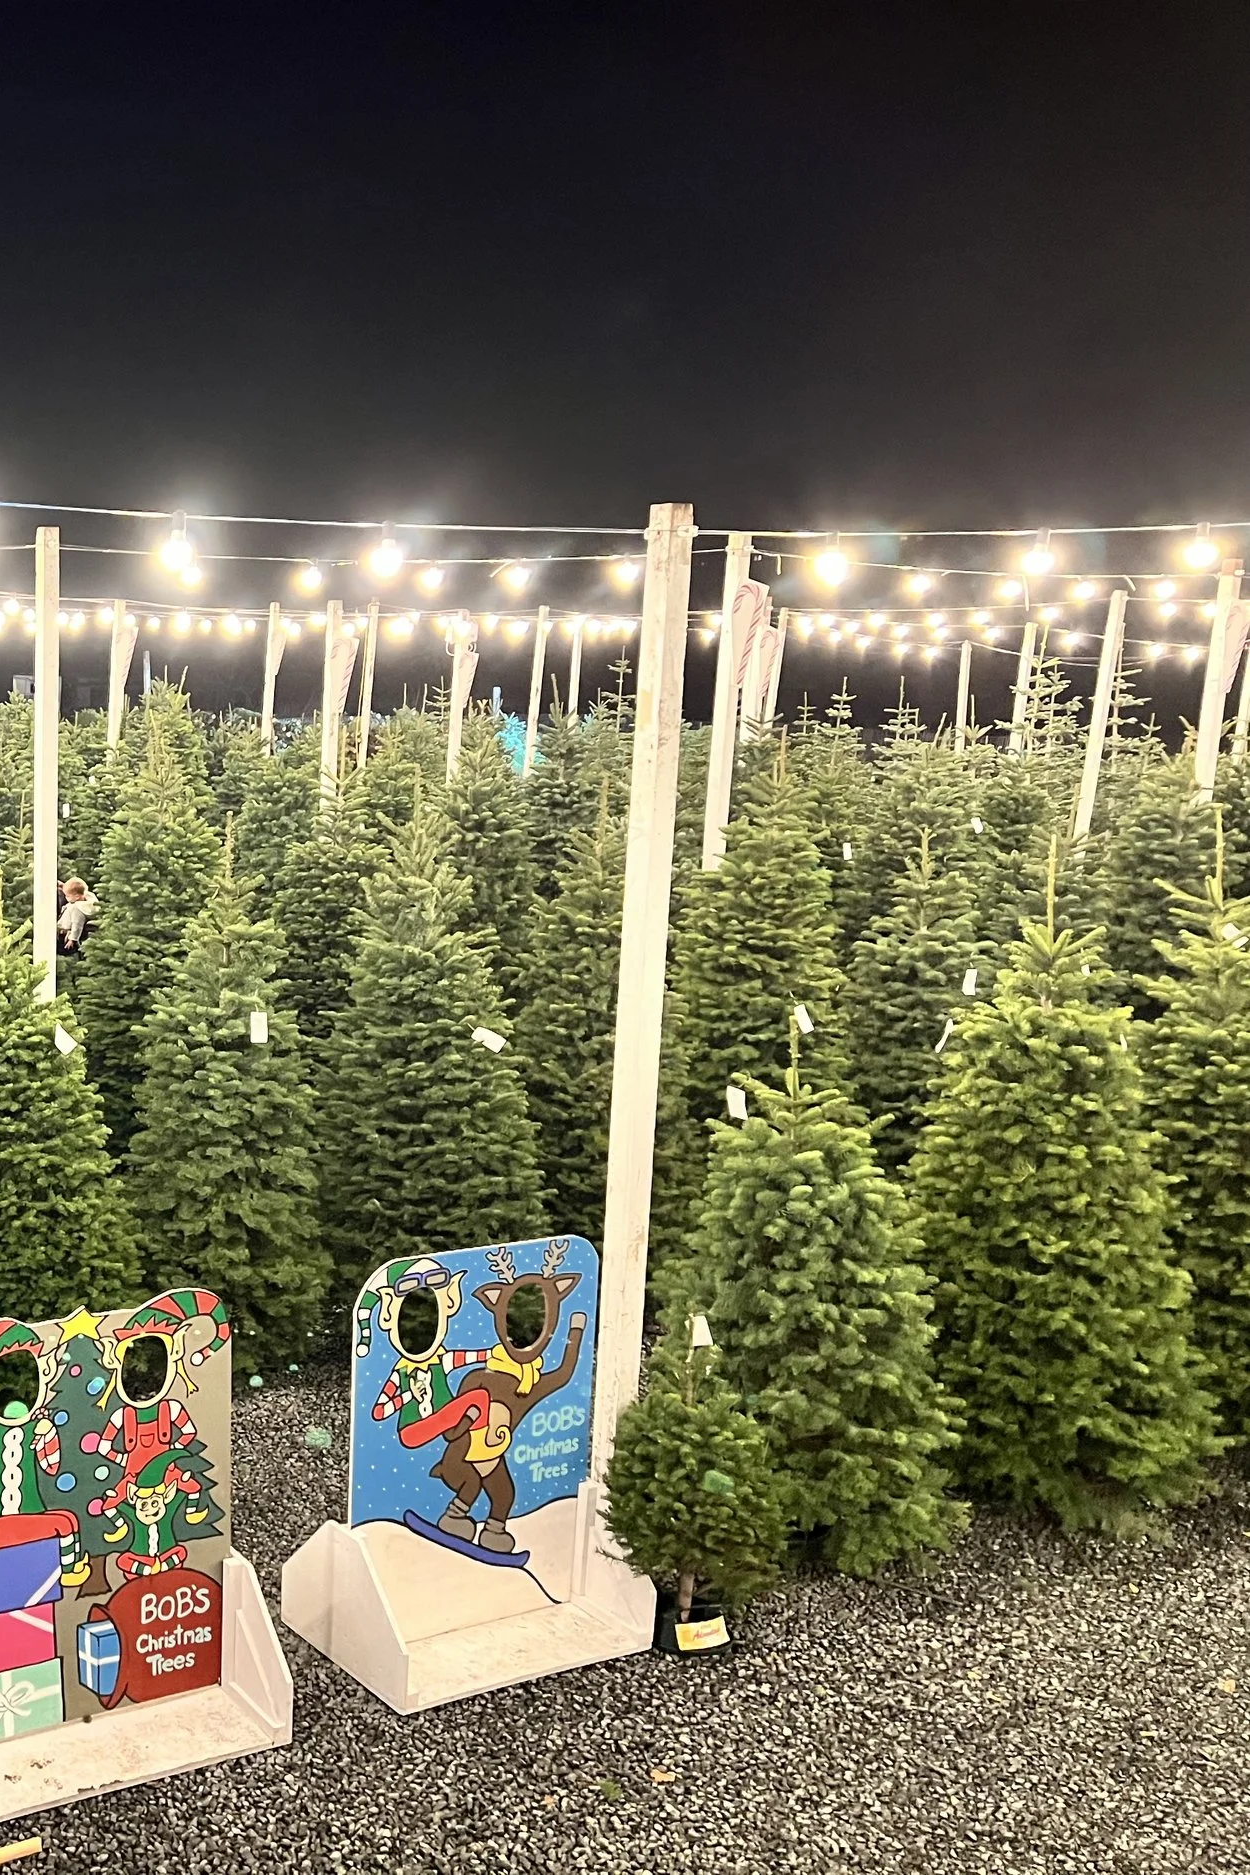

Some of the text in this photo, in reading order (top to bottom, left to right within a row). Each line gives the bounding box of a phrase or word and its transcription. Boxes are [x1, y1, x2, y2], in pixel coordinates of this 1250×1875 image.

[513, 1437, 579, 1464] Christmas
[528, 1461, 569, 1483] Trees
[135, 1623, 212, 1654] Christmas
[145, 1652, 196, 1677] Trees
